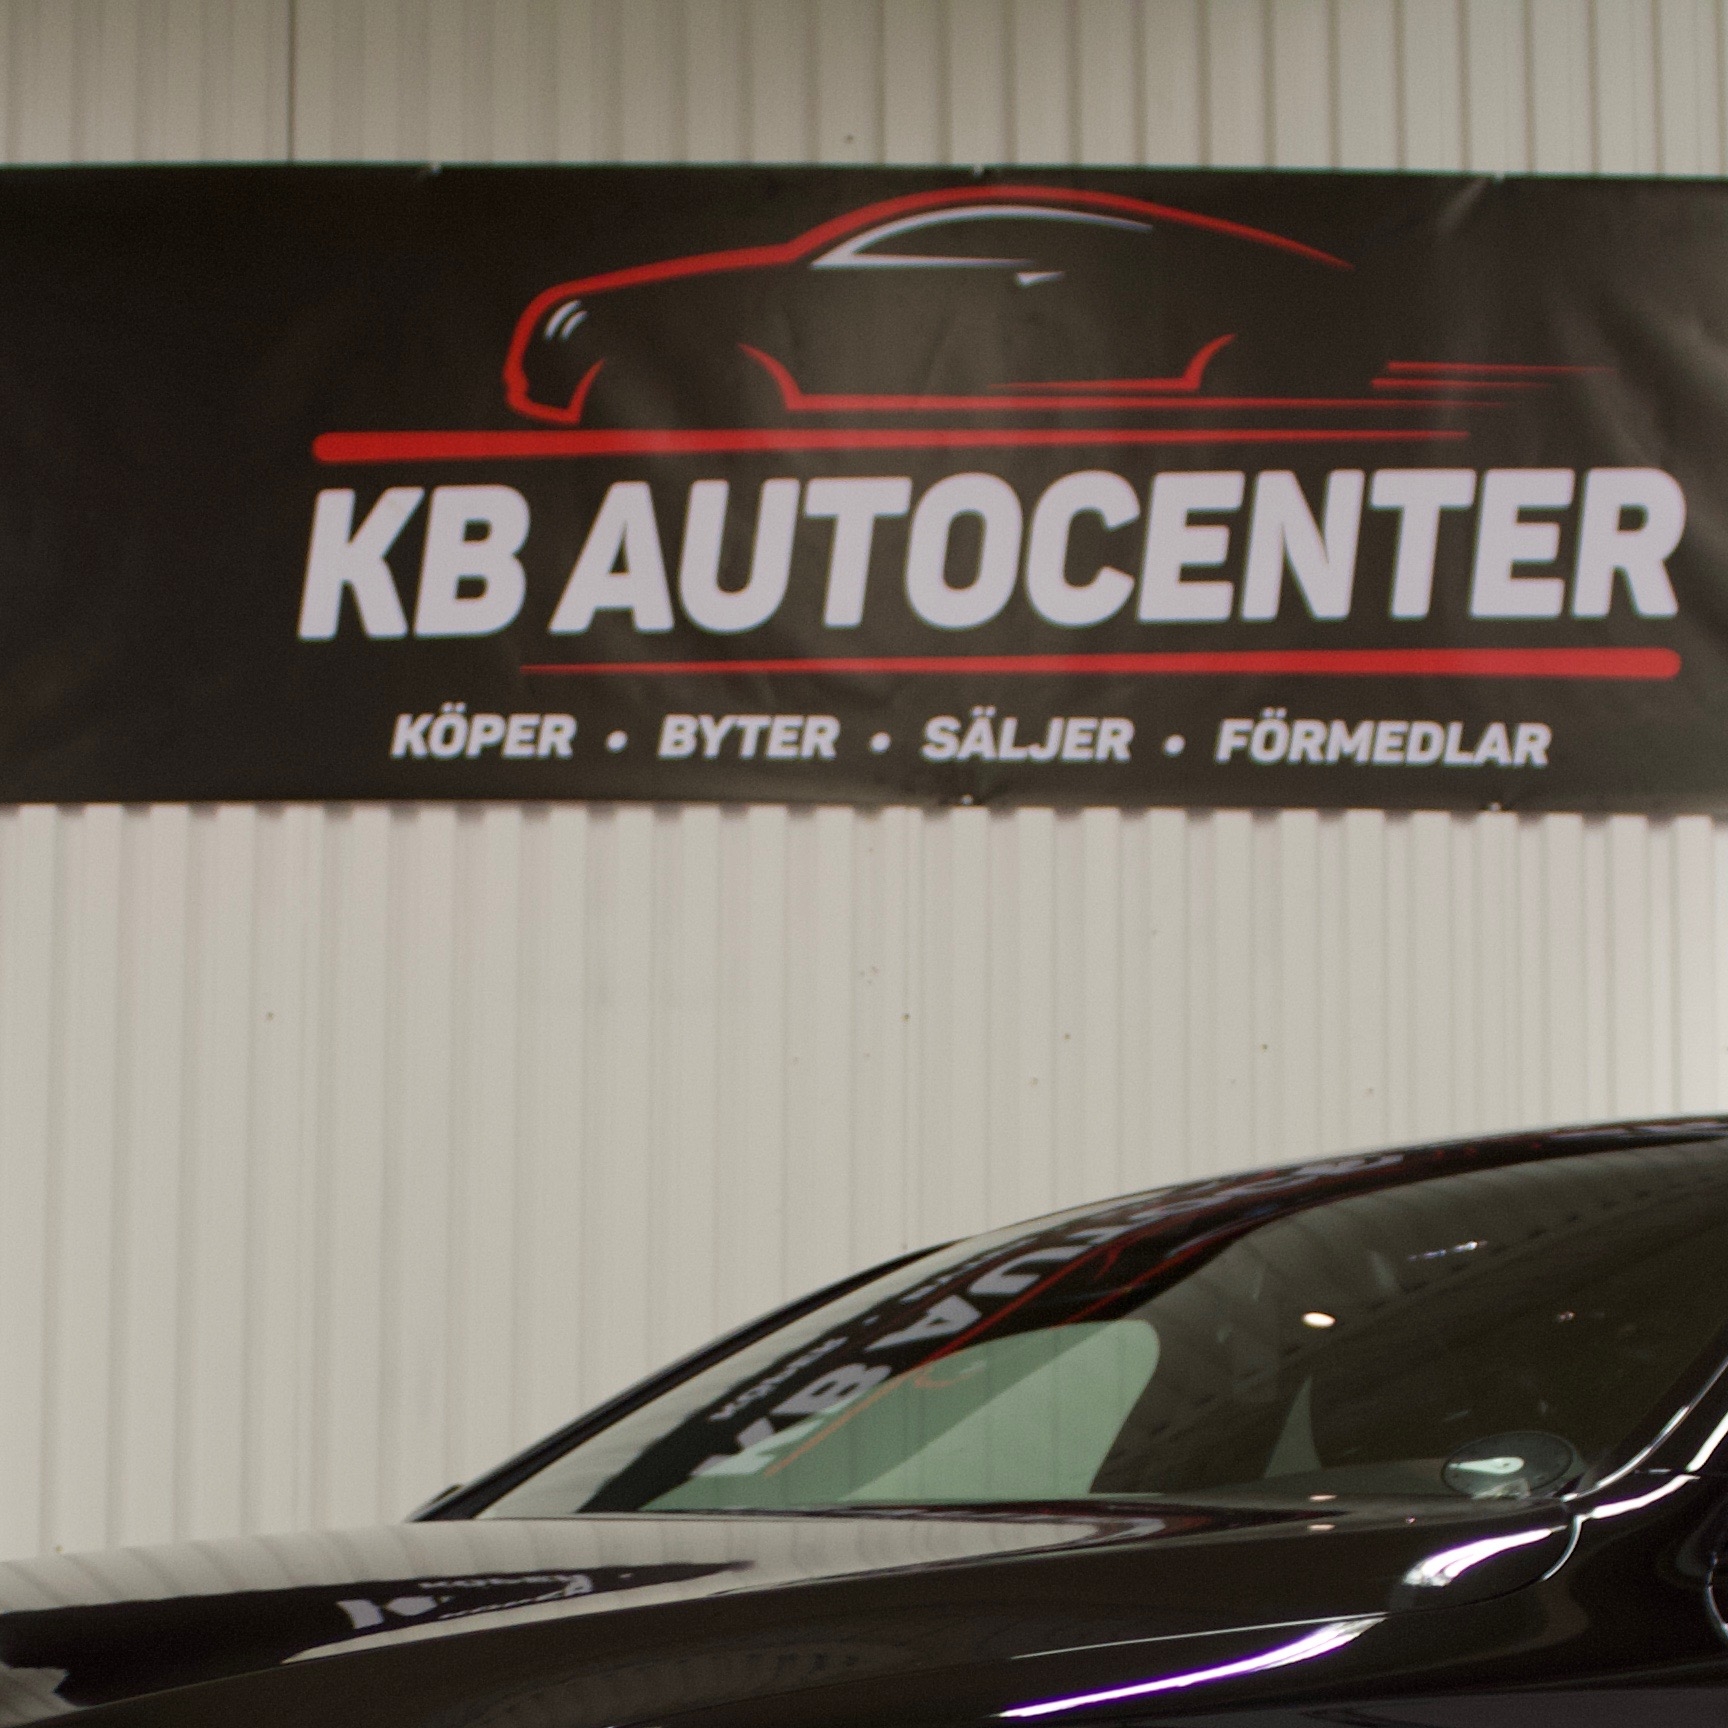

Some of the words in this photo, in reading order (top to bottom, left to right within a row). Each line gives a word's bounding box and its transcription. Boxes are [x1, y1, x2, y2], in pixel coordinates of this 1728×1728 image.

[298, 485, 530, 640] KB
[549, 467, 1687, 634] AUTOCENTER
[391, 702, 577, 758] KÖPER
[658, 714, 841, 760] BYTER
[921, 705, 1135, 762] SÄLJER
[1215, 707, 1552, 767] FÖRMEDLAR
